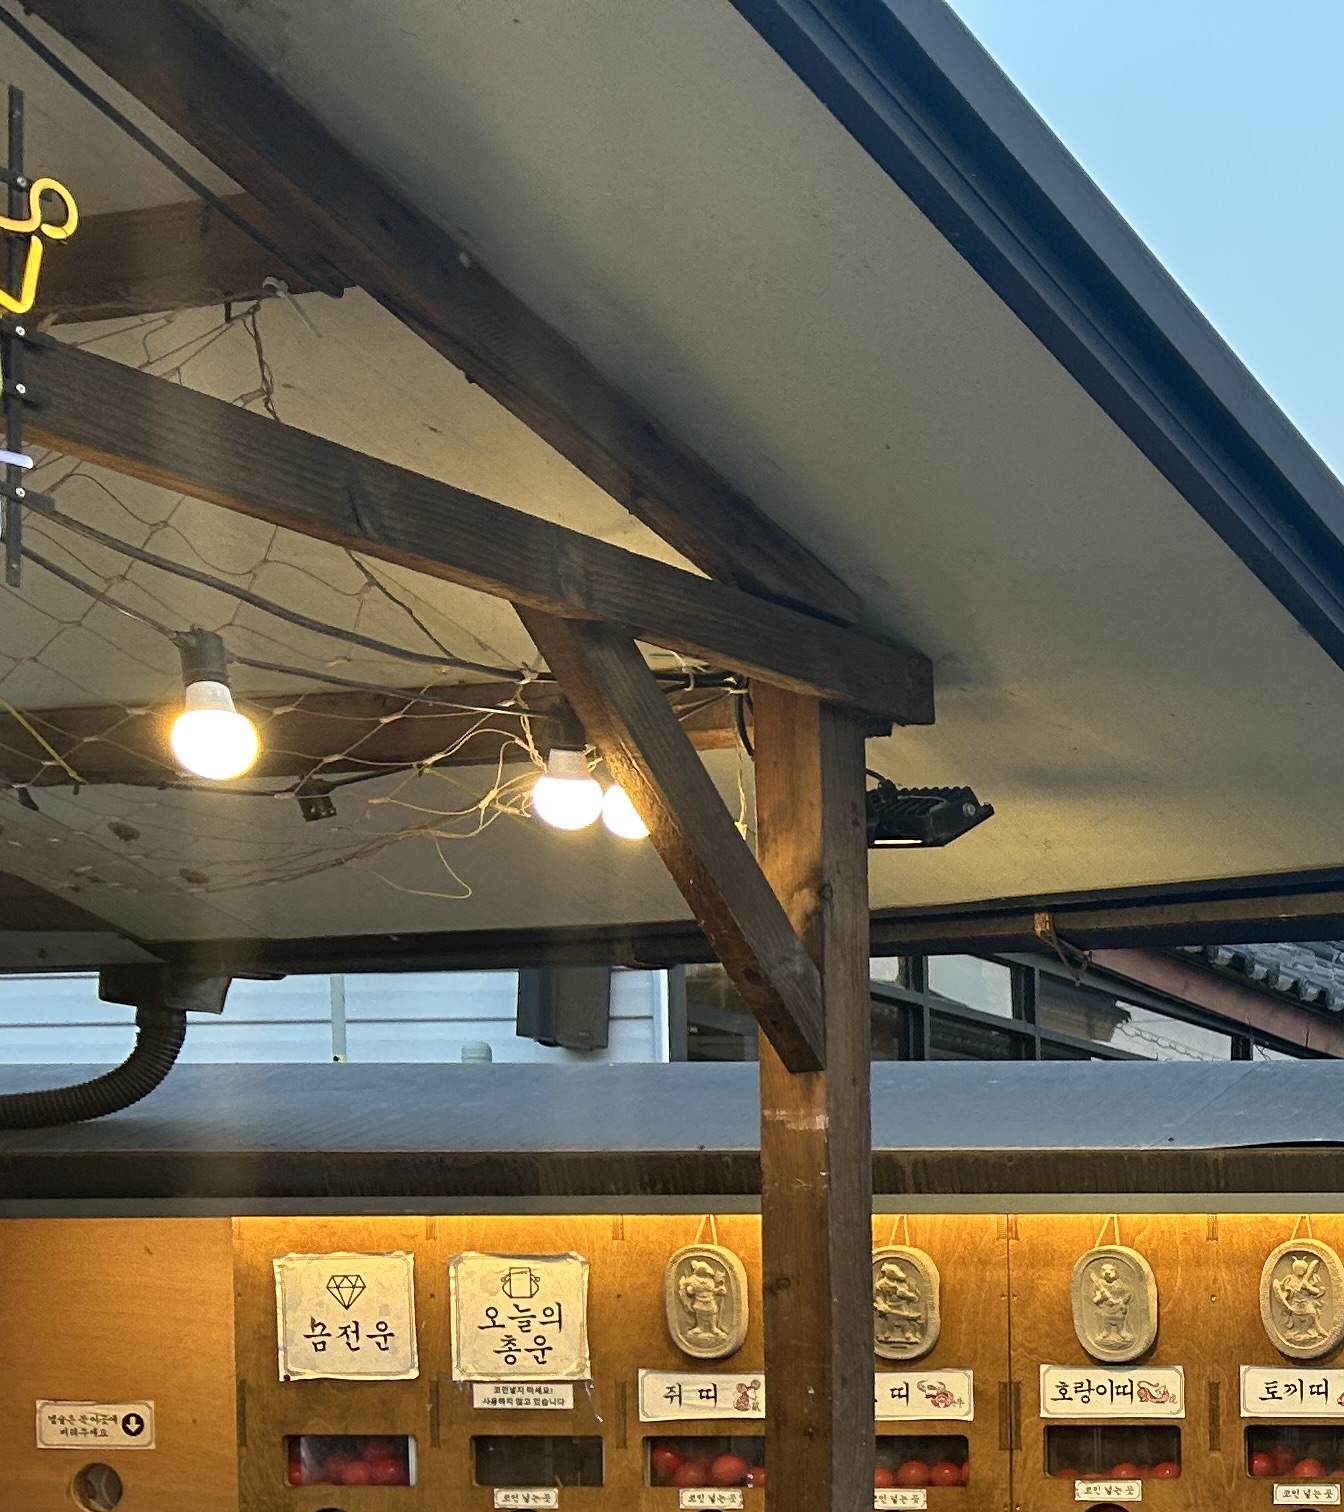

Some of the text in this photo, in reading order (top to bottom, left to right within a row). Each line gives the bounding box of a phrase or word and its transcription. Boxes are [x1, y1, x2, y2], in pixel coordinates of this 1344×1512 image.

[477, 1302, 563, 1334] 오늘의
[492, 1334, 555, 1365] 총운
[663, 1383, 718, 1409] 쥐 띠
[890, 1383, 910, 1408] 띠
[1050, 1378, 1133, 1405] 호랑이띠
[1258, 1378, 1328, 1405] 토끼띠
[502, 1493, 552, 1503] 코인 넣는 곳
[688, 1493, 737, 1503] 코인 넣는 곳
[875, 1494, 920, 1504] 인 넣는 곳
[1084, 1485, 1135, 1496] 코인 넣는 곳
[1282, 1488, 1333, 1499] 코인 넣는 곳
